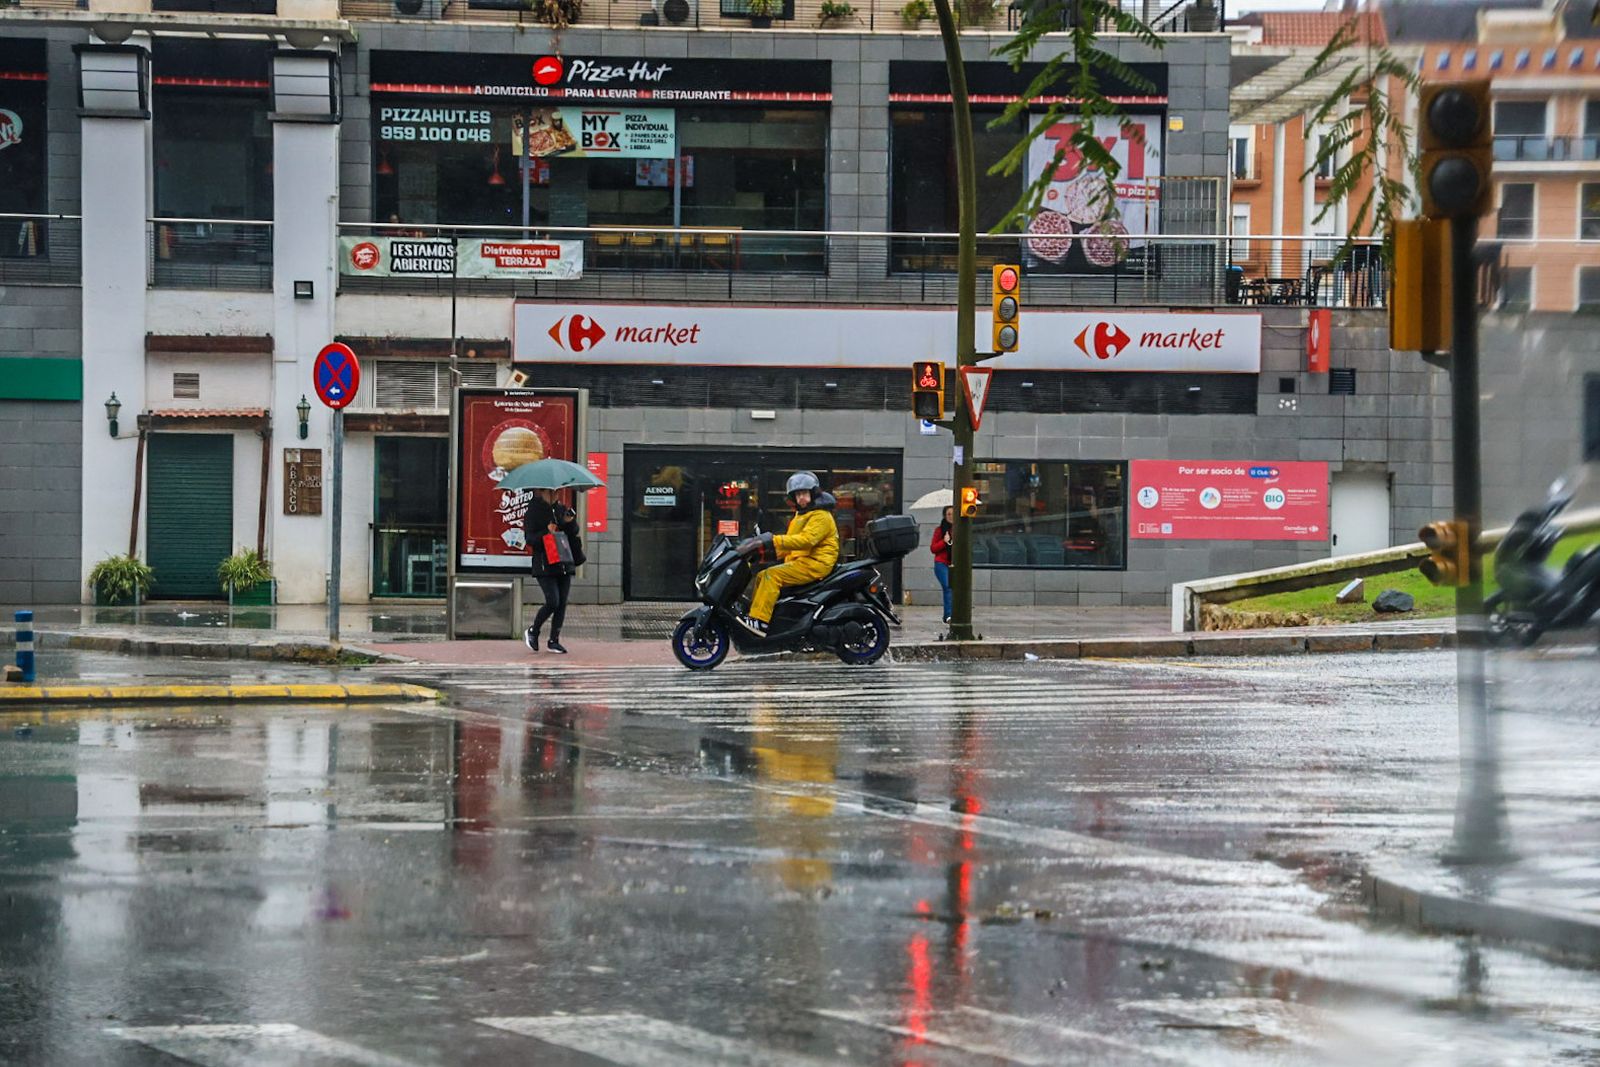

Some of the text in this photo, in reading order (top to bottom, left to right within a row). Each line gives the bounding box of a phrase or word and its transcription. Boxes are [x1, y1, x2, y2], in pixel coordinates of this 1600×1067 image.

[566, 59, 672, 83] Pizza Hut
[474, 85, 549, 96] A DOMICILIO
[564, 88, 637, 99] PARA LLEVAR
[652, 90, 731, 100] RESTAURANTE
[380, 107, 491, 124] PIZZAHUT.ES
[625, 114, 648, 122] PIZZA
[581, 115, 609, 131] MY
[625, 123, 669, 131] INDIVIDUAL
[380, 125, 491, 142] 959 100 046
[581, 132, 620, 148] BOX
[484, 245, 558, 257] Disfruta nuestra
[393, 257, 454, 271] ABIERTOS!
[499, 256, 542, 267] TERRAZA
[615, 322, 700, 346] market
[1139, 328, 1225, 351] market
[1178, 466, 1194, 475] Por
[1211, 467, 1232, 475] socio
[1234, 467, 1245, 475] de
[645, 486, 674, 494] AENOR
[1265, 495, 1283, 503] BIO
[502, 507, 528, 522] NOS UN
